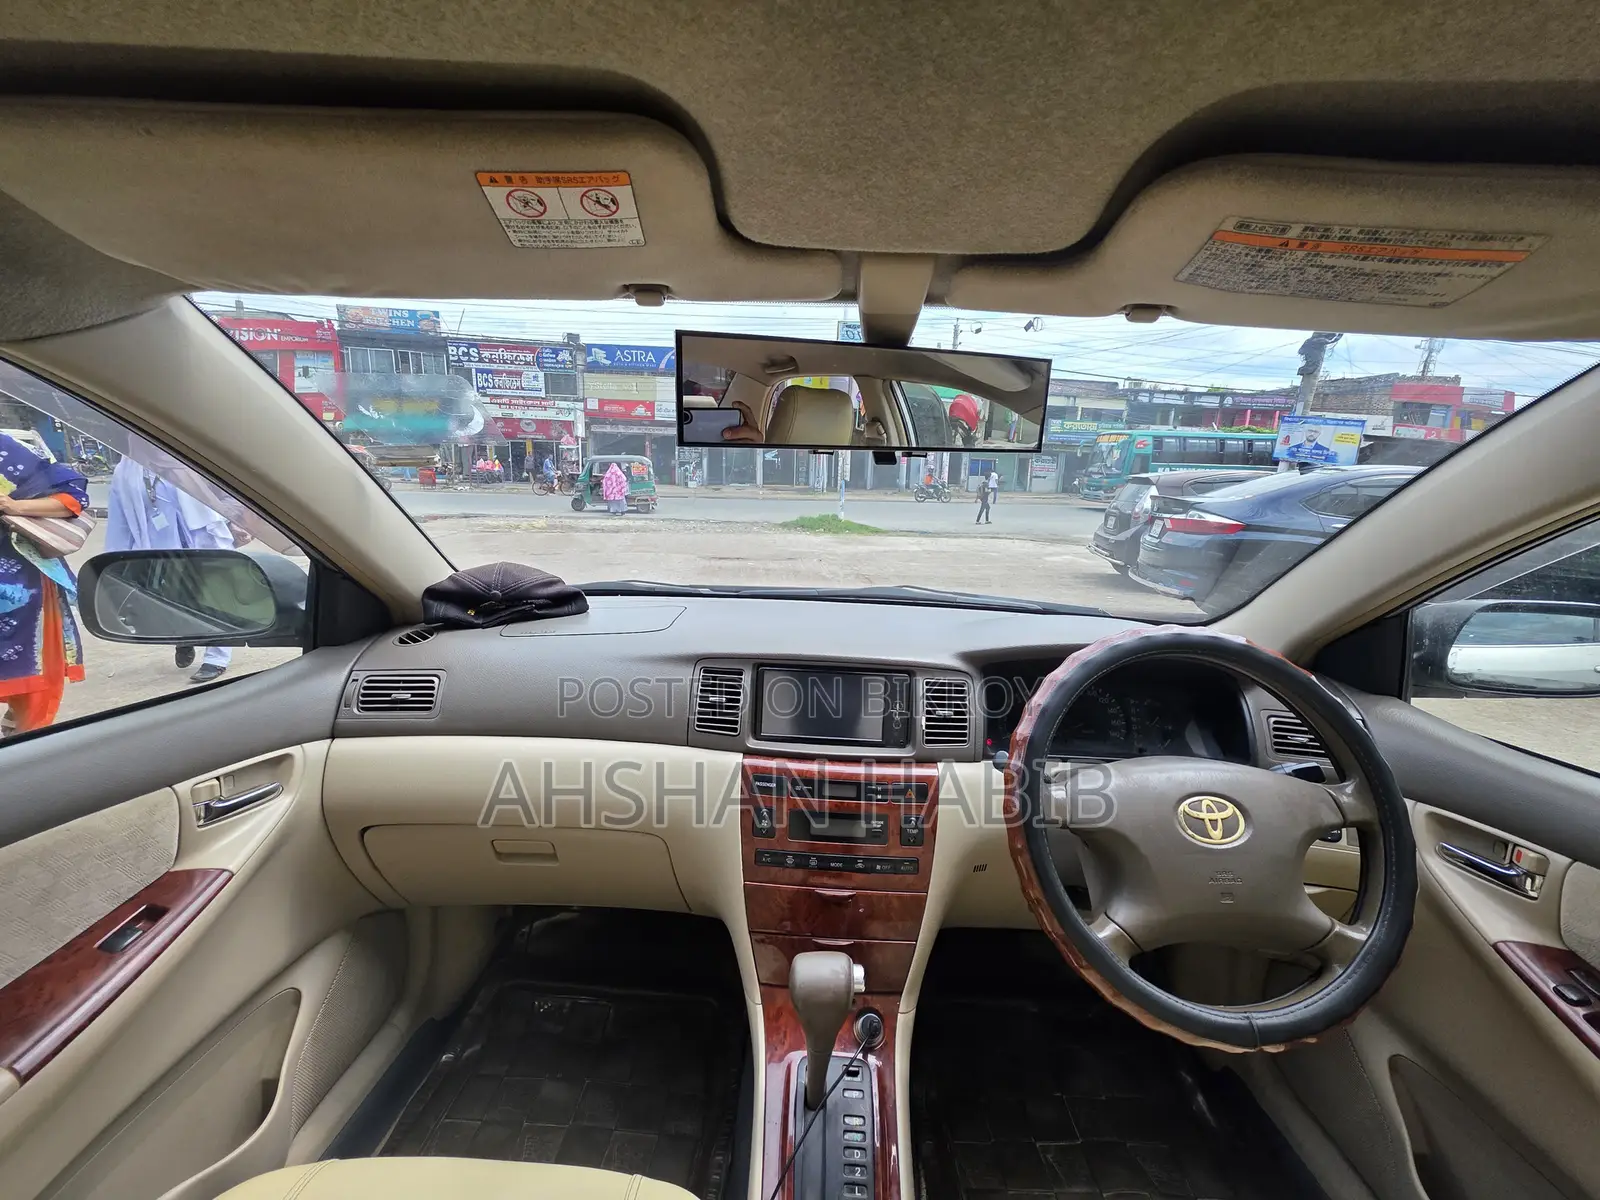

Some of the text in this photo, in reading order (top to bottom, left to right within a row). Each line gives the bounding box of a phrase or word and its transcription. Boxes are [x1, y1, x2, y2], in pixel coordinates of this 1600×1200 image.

[448, 346, 479, 362] BCS
[614, 349, 656, 363] ASTRA
[477, 373, 493, 388] BCS
[854, 1150, 861, 1159] D
[855, 1167, 861, 1177] 2
[855, 1186, 862, 1196] L
